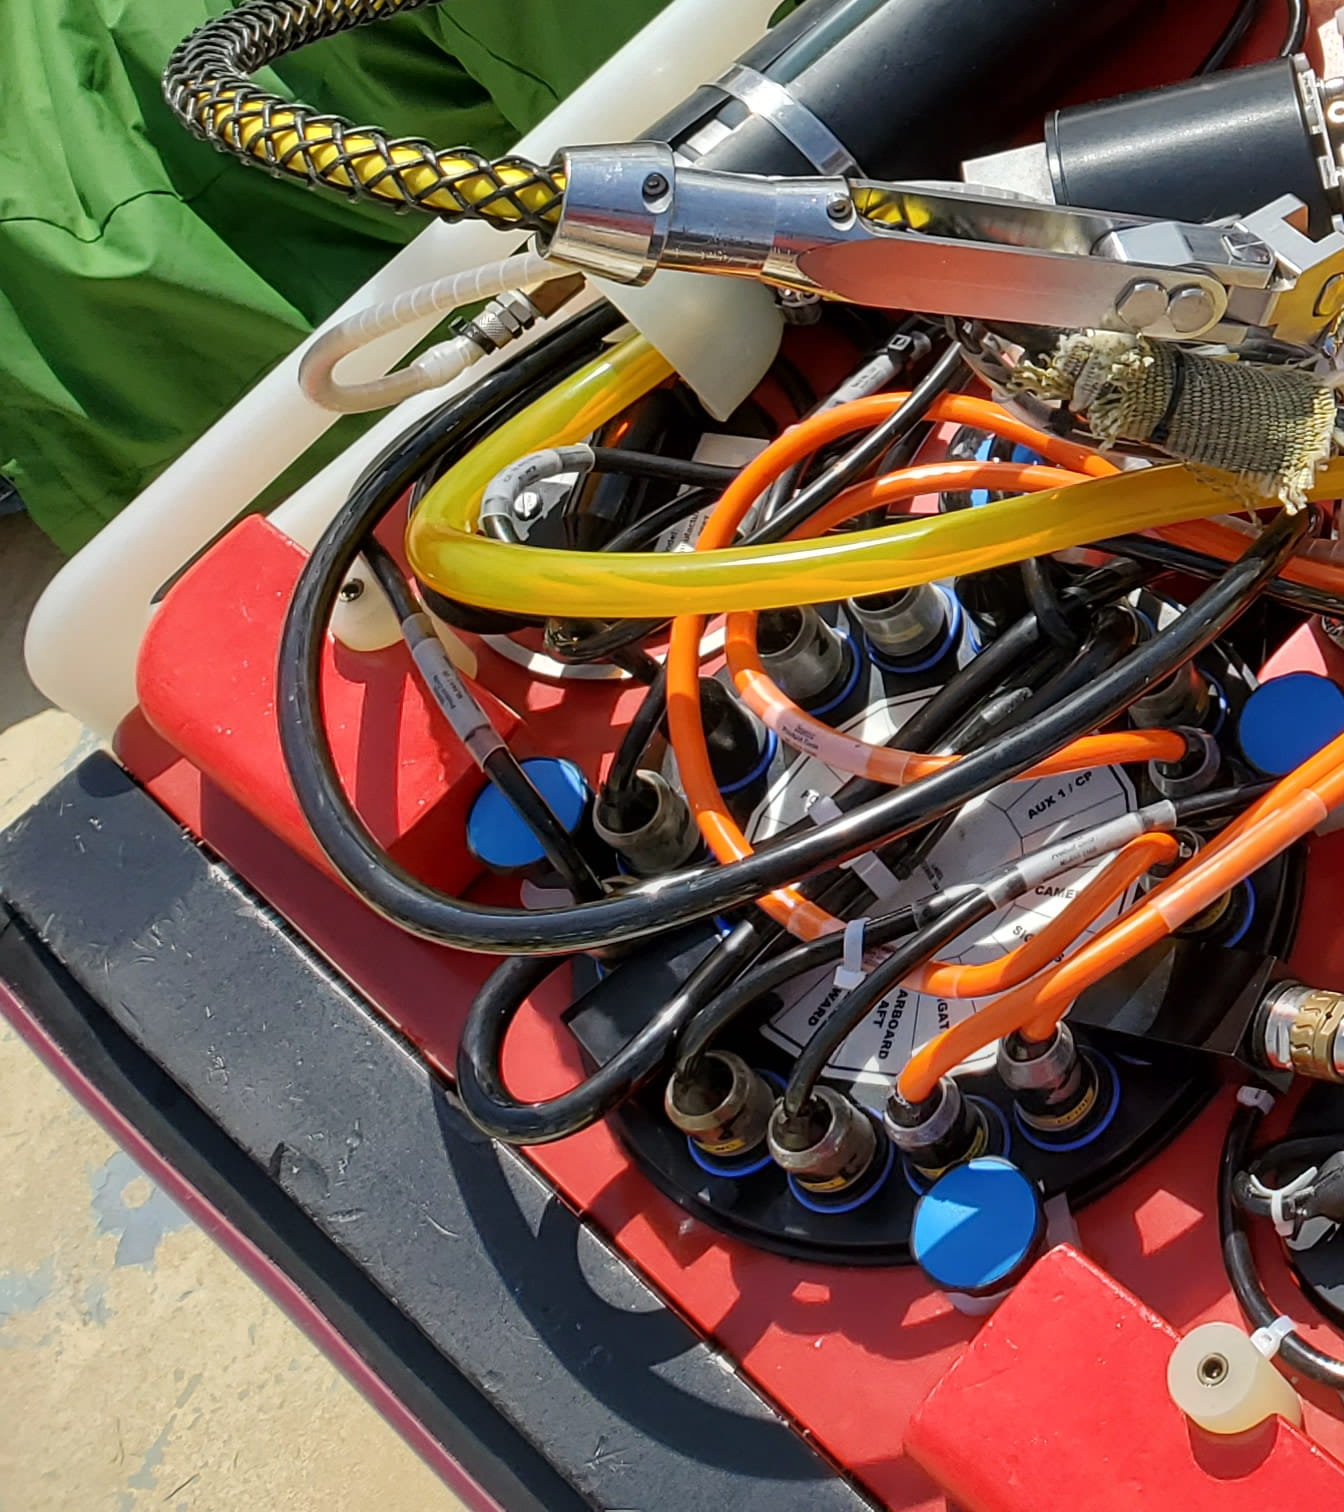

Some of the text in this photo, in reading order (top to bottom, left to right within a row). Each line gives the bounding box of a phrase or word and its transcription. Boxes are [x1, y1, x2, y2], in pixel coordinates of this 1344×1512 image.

[1028, 796, 1056, 819] AUX
[1075, 770, 1094, 788] CP
[1034, 884, 1078, 900] CAME
[807, 986, 842, 1027] WARD
[873, 1000, 890, 1028] AFT
[877, 989, 909, 1061] ARBOARD
